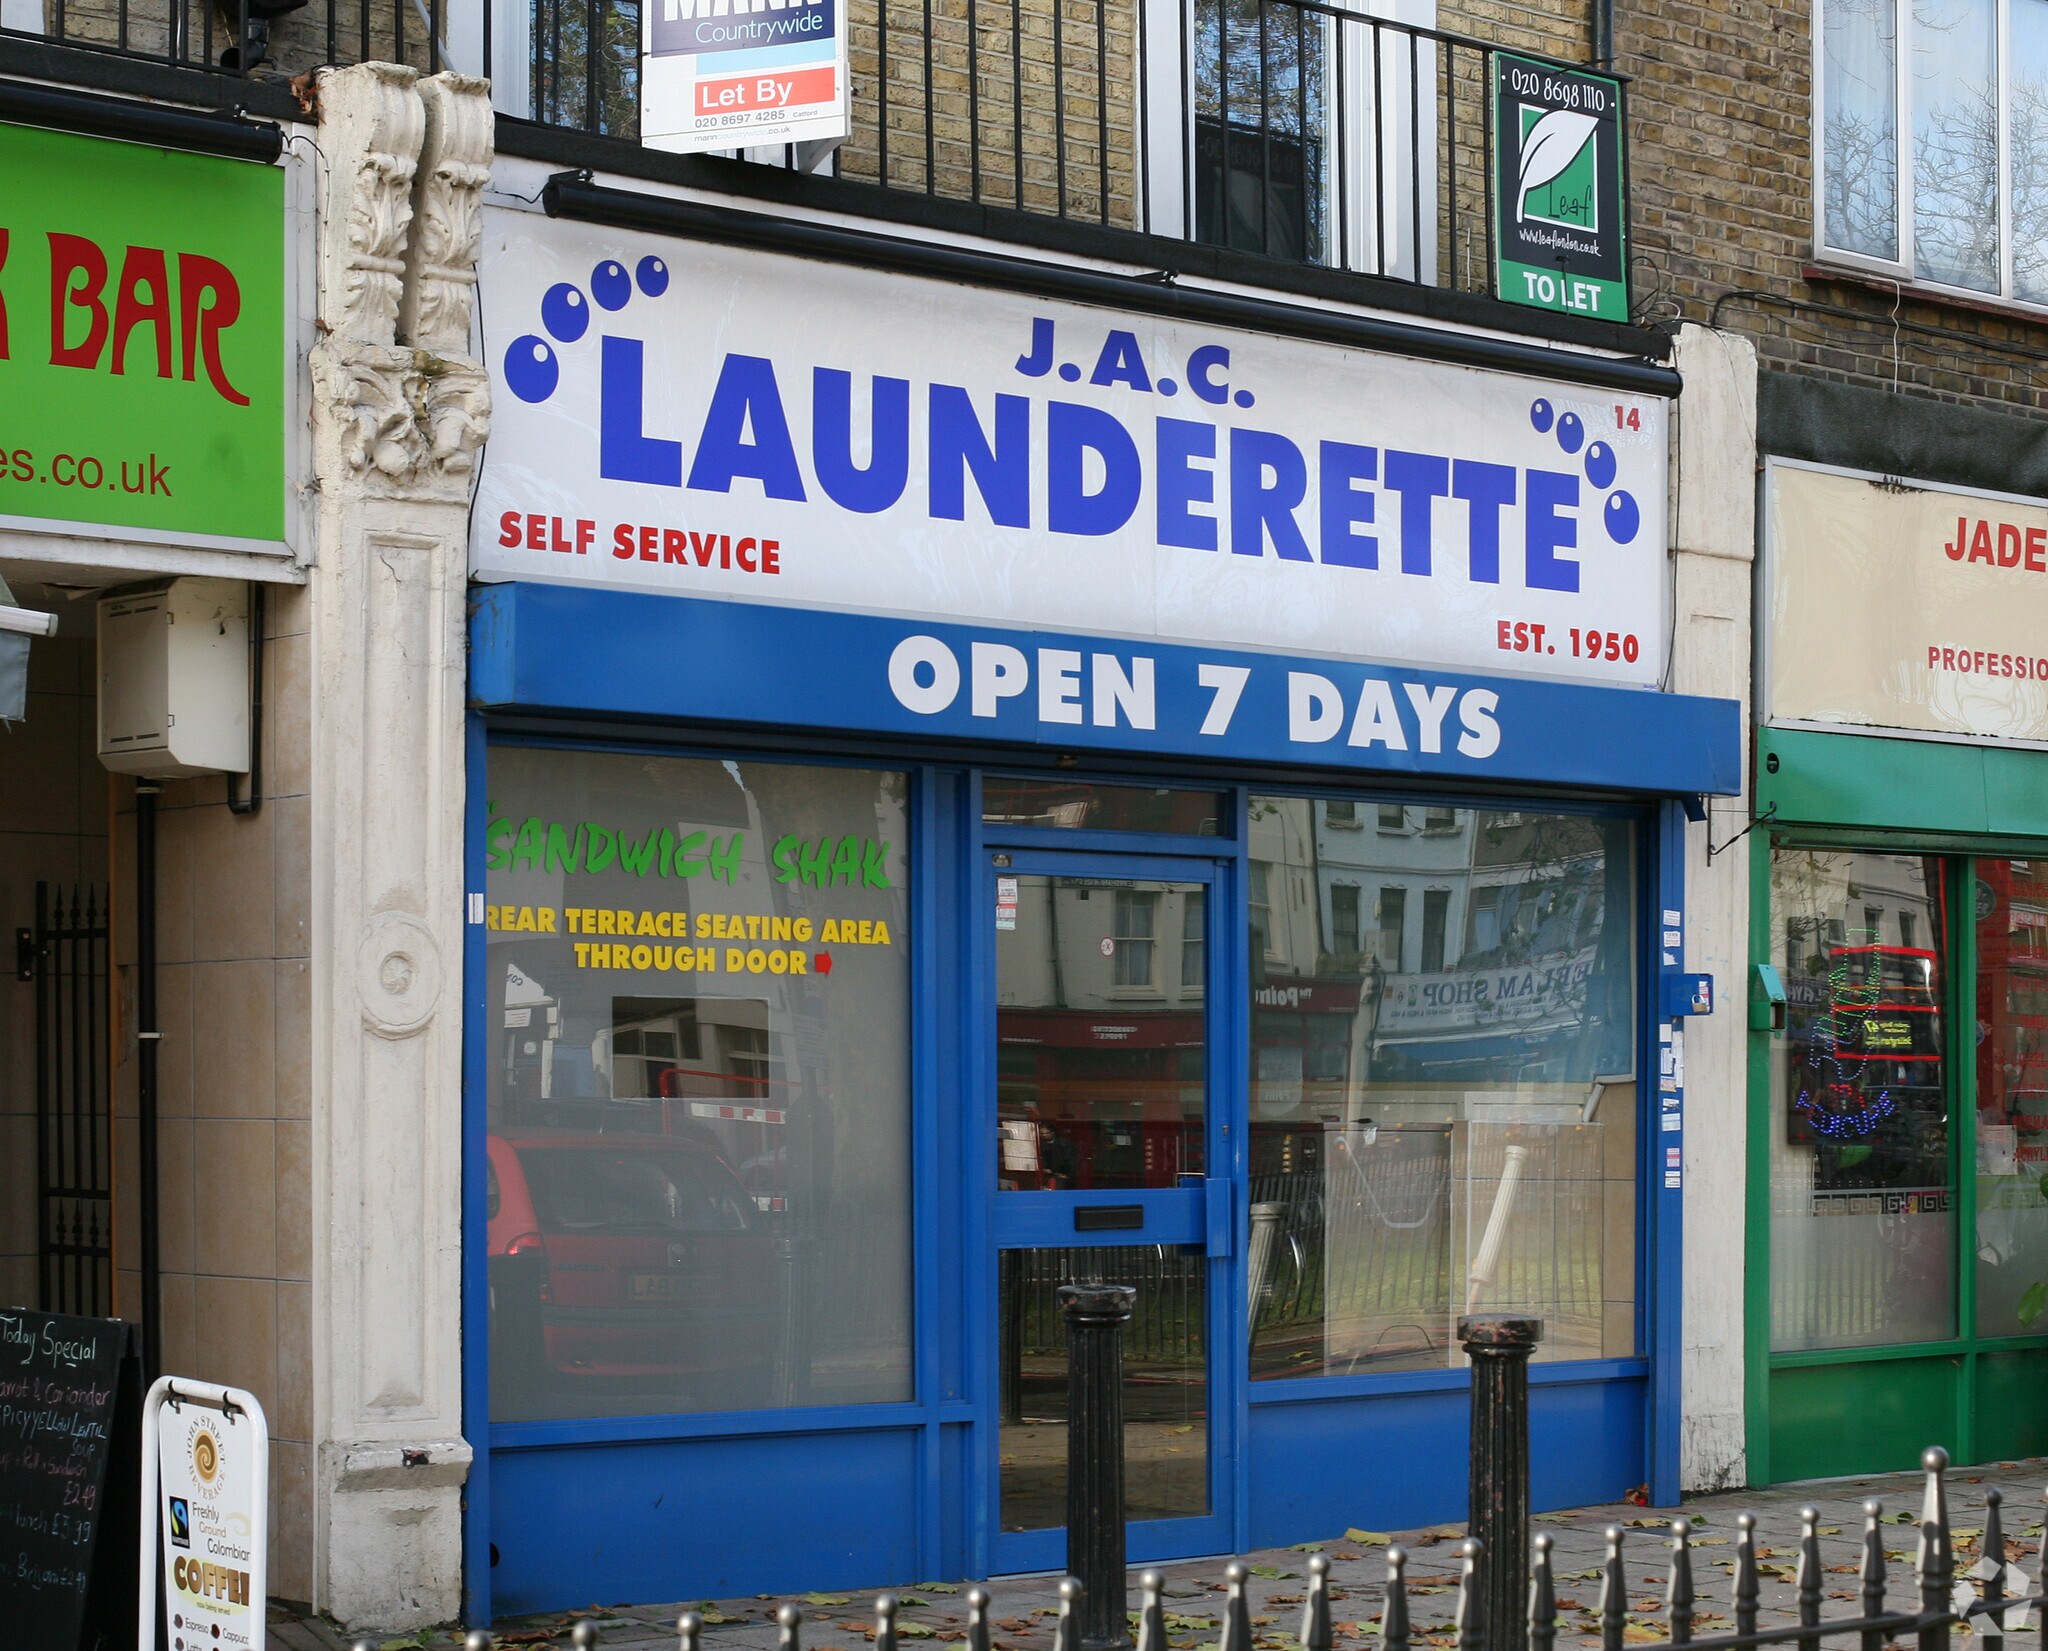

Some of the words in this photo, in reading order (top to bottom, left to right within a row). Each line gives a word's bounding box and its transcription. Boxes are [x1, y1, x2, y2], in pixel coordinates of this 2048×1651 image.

[696, 10, 823, 43] Countrywide
[702, 83, 745, 108] Let
[757, 79, 793, 106] By
[1512, 68, 1539, 95] 020
[1544, 77, 1579, 109] 8698
[1583, 84, 1605, 112] 1110
[695, 118, 718, 129] 020
[721, 113, 751, 126] 8697
[755, 109, 785, 121] 4285
[1548, 180, 1592, 226] Leaf
[1523, 272, 1555, 303] TO
[1560, 279, 1601, 312] LET
[46, 231, 250, 407] BAR
[1015, 317, 1256, 409] J.A.C.
[1614, 405, 1641, 432] 14
[600, 335, 1580, 594] LAUNDERETTE
[498, 511, 596, 555] SELF
[612, 523, 781, 575] SERVICE
[1944, 516, 2047, 573] JADE
[1497, 619, 1556, 655] EST.
[1569, 628, 1640, 664] 1950
[888, 635, 1156, 731] OPEN
[1198, 663, 1252, 736] 7
[1288, 671, 1501, 759] DAYS
[486, 816, 744, 885] SANDWICH
[772, 833, 891, 889] SHAK
[487, 905, 557, 933] REAR
[564, 907, 687, 938] TERRACE
[695, 913, 812, 942] SEATING
[820, 919, 891, 945] AREA
[573, 943, 715, 972] THROUGH
[726, 948, 807, 975] DOOR
[0, 1313, 36, 1365] Today
[41, 1320, 97, 1369] Special
[186, 1417, 200, 1459] JOHN
[192, 1502, 219, 1523] Freshly
[199, 1522, 227, 1538] Ground
[174, 1555, 250, 1606] COFFEE
